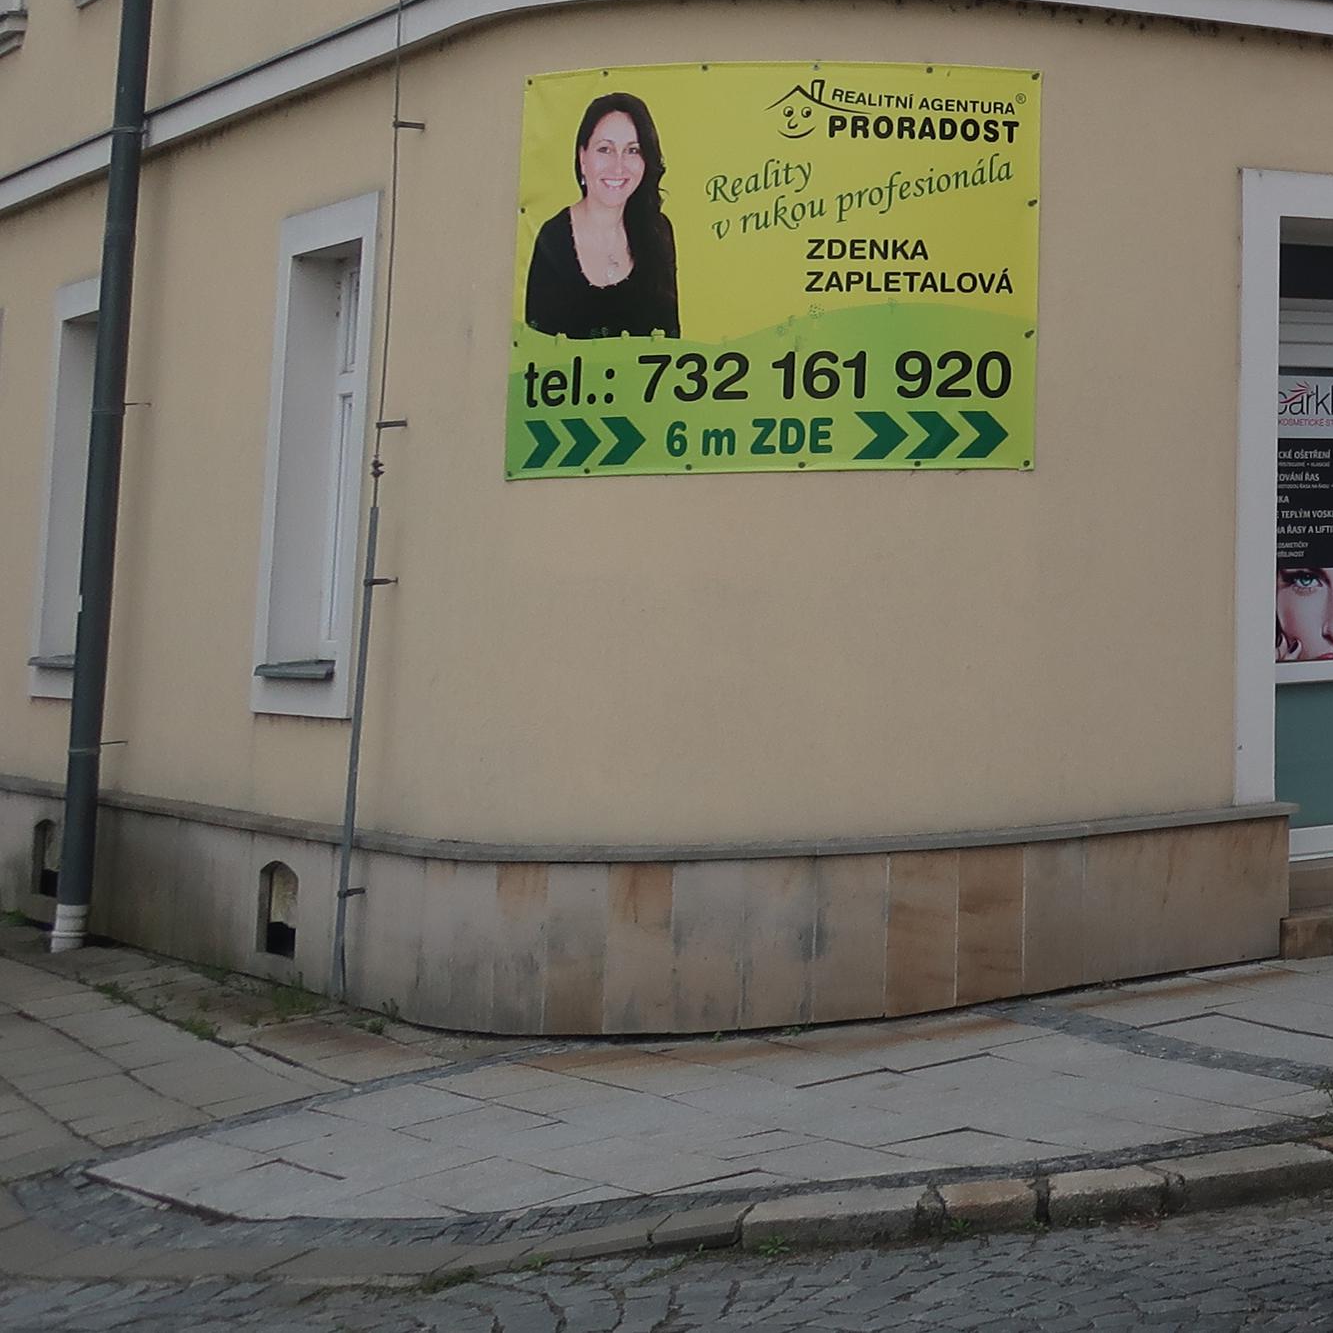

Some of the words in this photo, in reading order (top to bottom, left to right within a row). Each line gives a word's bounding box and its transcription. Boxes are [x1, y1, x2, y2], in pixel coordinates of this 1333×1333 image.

[832, 88, 914, 110] REALITNÍ
[918, 97, 1015, 115] AGENTURA
[828, 116, 1019, 144] PRORADOST
[706, 158, 812, 204] Reality
[711, 219, 730, 241] v
[739, 195, 826, 233] rukou
[836, 154, 1013, 225] profesionála
[806, 238, 929, 261] ZDENKA
[805, 268, 1013, 295] ZAPLETALOVÁ
[524, 355, 616, 408] tel.:
[637, 352, 749, 403] 732
[771, 350, 867, 400] 161
[895, 350, 1013, 398] 920
[665, 421, 688, 457] 6
[702, 425, 736, 456] m
[750, 417, 833, 455] ZDE
